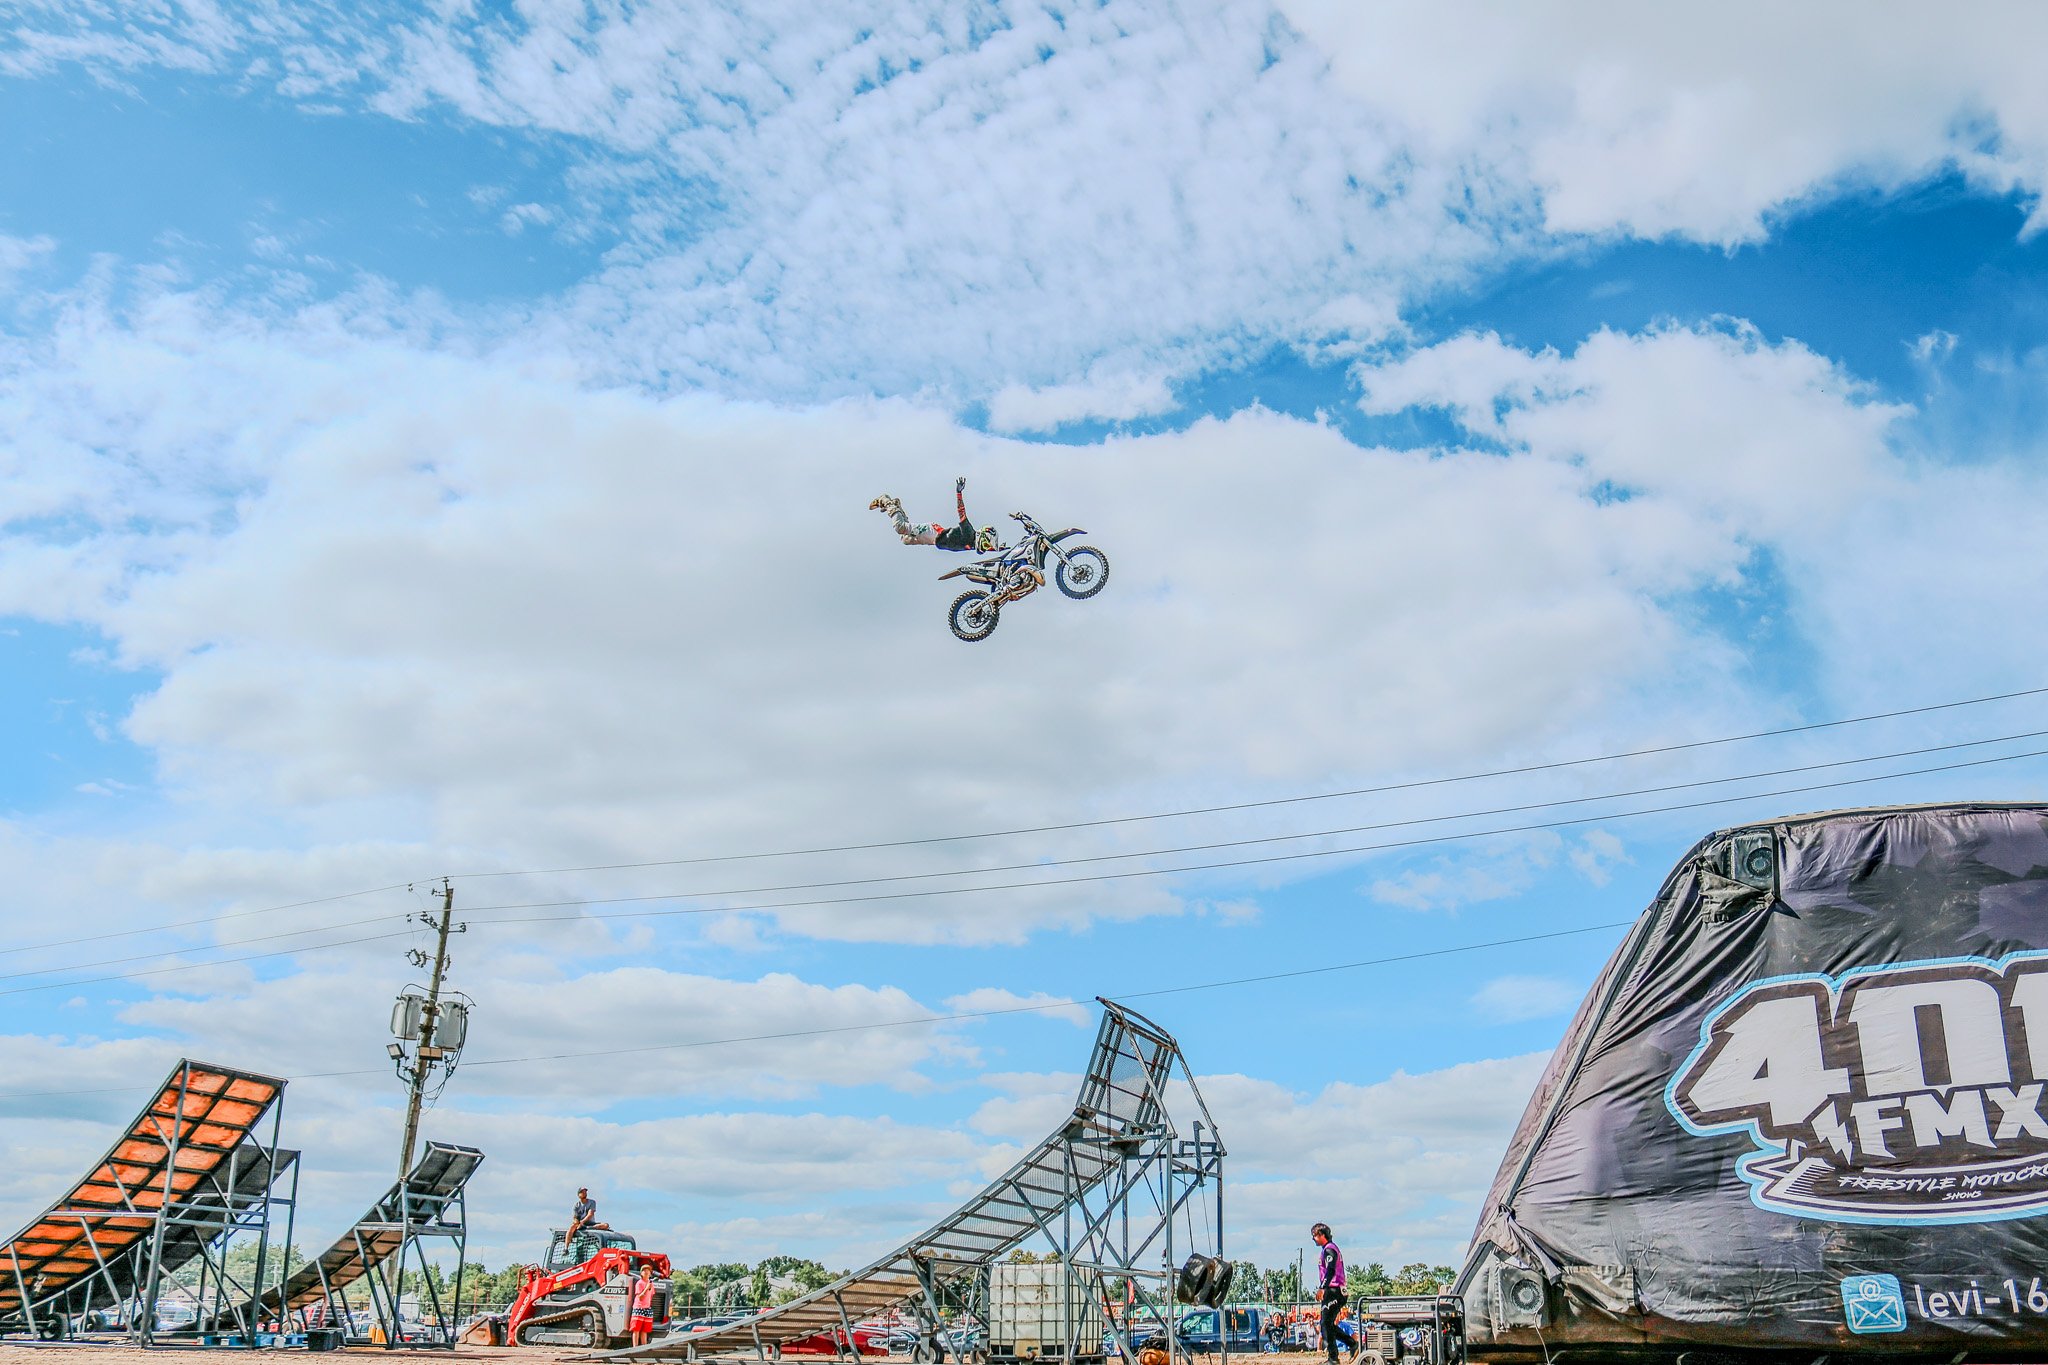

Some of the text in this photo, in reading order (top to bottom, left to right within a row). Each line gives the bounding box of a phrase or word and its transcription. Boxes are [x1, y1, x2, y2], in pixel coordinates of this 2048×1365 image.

[1850, 1083, 2048, 1159] FMX
[1837, 1175, 1957, 1193] FREESTYLE
[1942, 1190, 1981, 1200] SHOWS
[1914, 1277, 2048, 1318] levi-16
